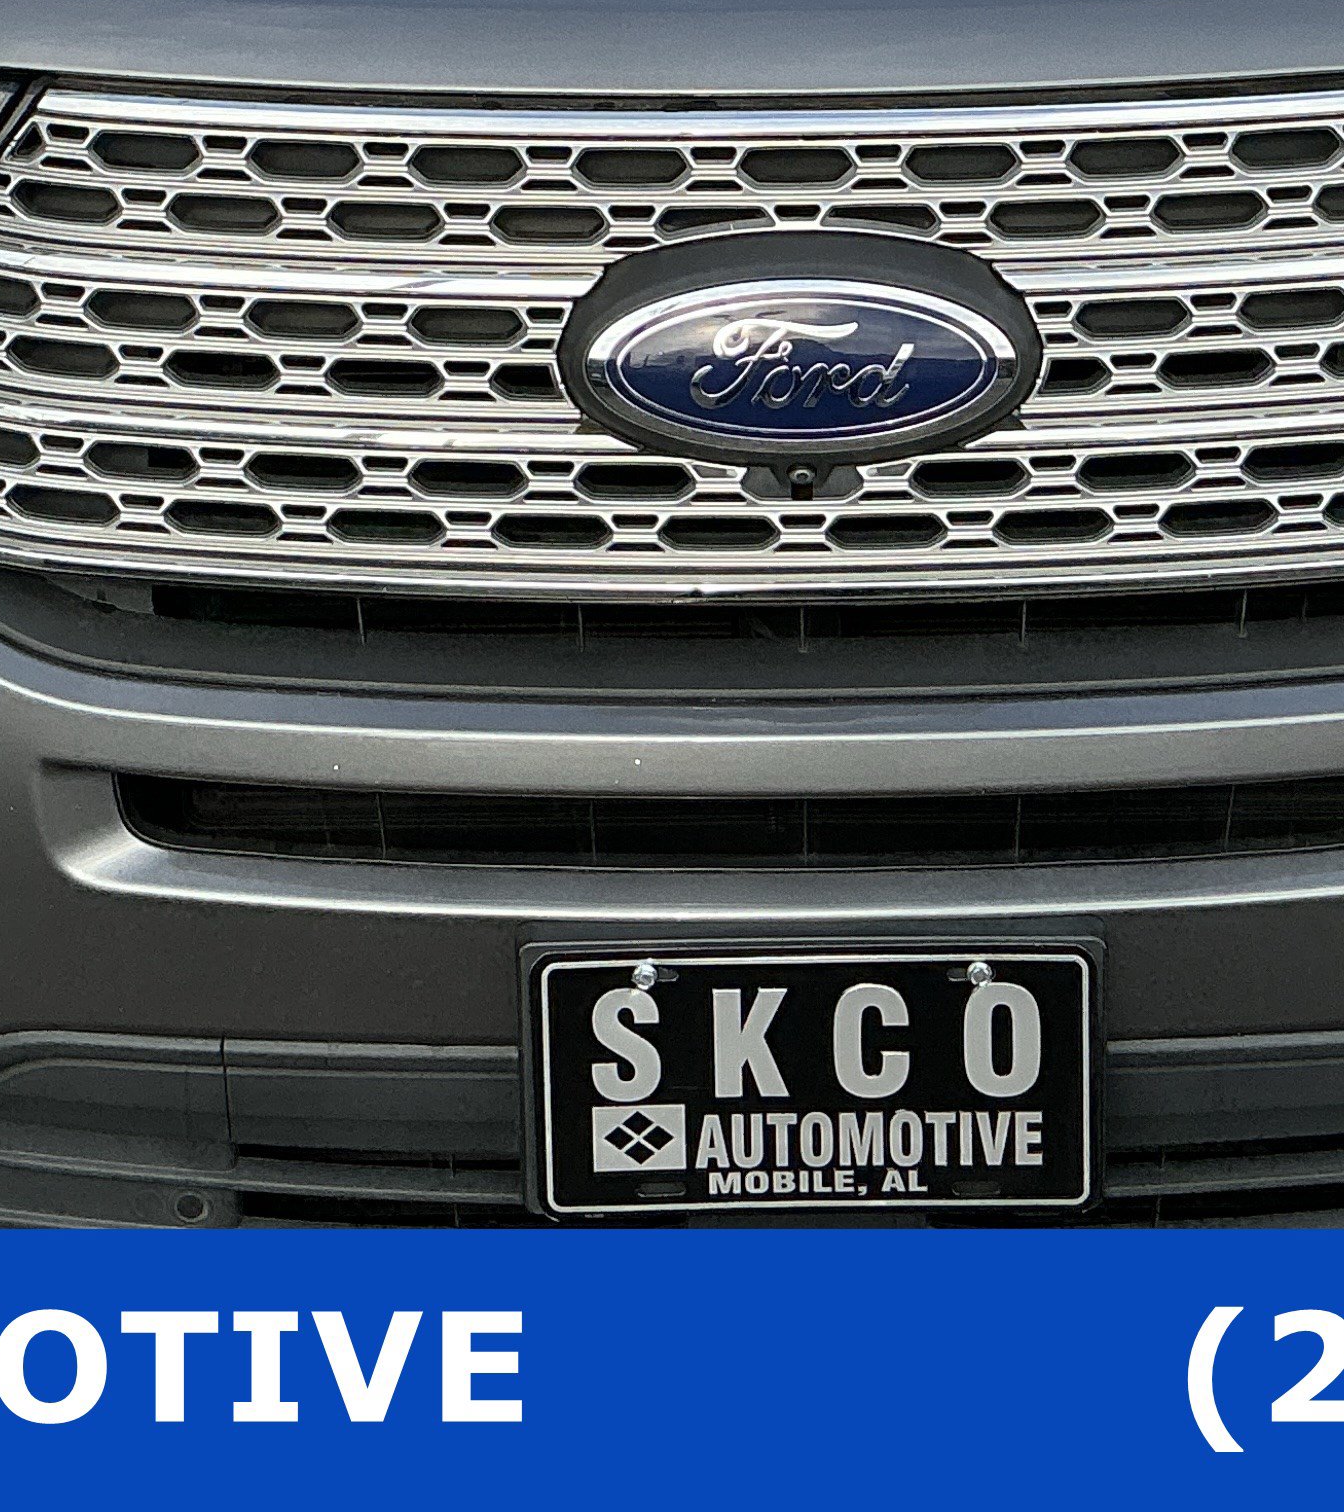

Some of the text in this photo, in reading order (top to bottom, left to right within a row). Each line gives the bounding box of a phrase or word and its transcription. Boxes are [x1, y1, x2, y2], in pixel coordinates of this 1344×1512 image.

[691, 318, 915, 409] Ford
[591, 982, 1042, 1102] SKCO
[695, 1108, 1044, 1170] AUTOMOTIVE
[708, 1167, 929, 1196] MOBILE, AL
